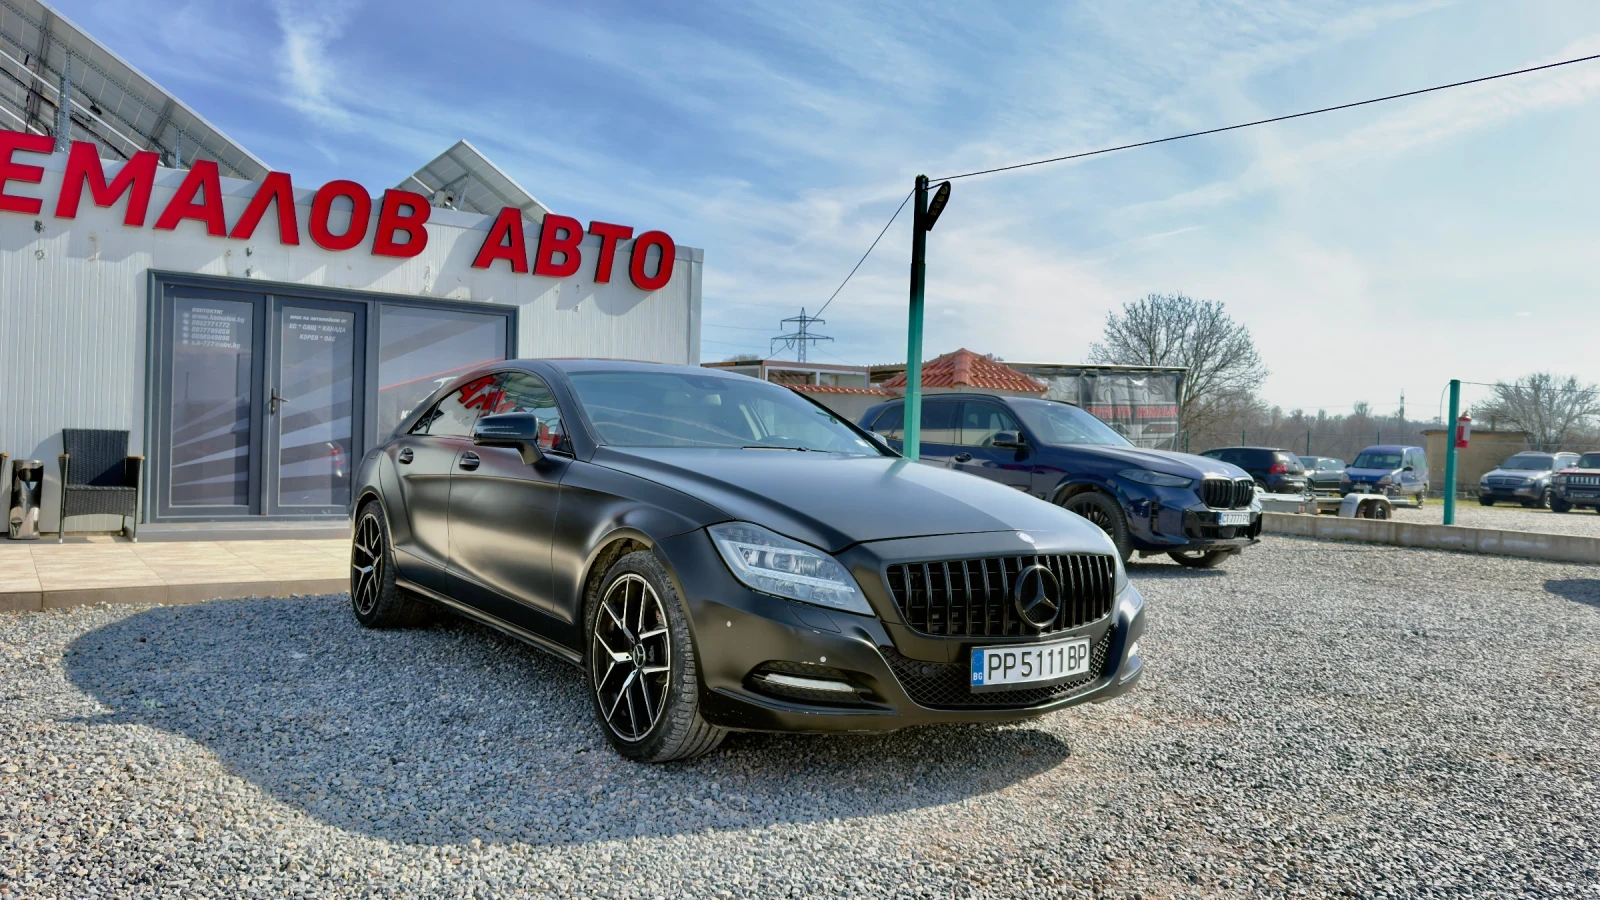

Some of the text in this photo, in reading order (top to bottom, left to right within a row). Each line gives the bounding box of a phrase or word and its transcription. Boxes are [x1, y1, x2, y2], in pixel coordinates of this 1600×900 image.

[0, 130, 676, 291] ЕМАЛОВ АВТО
[322, 325, 346, 333] КАНАДА
[973, 672, 983, 681] BG
